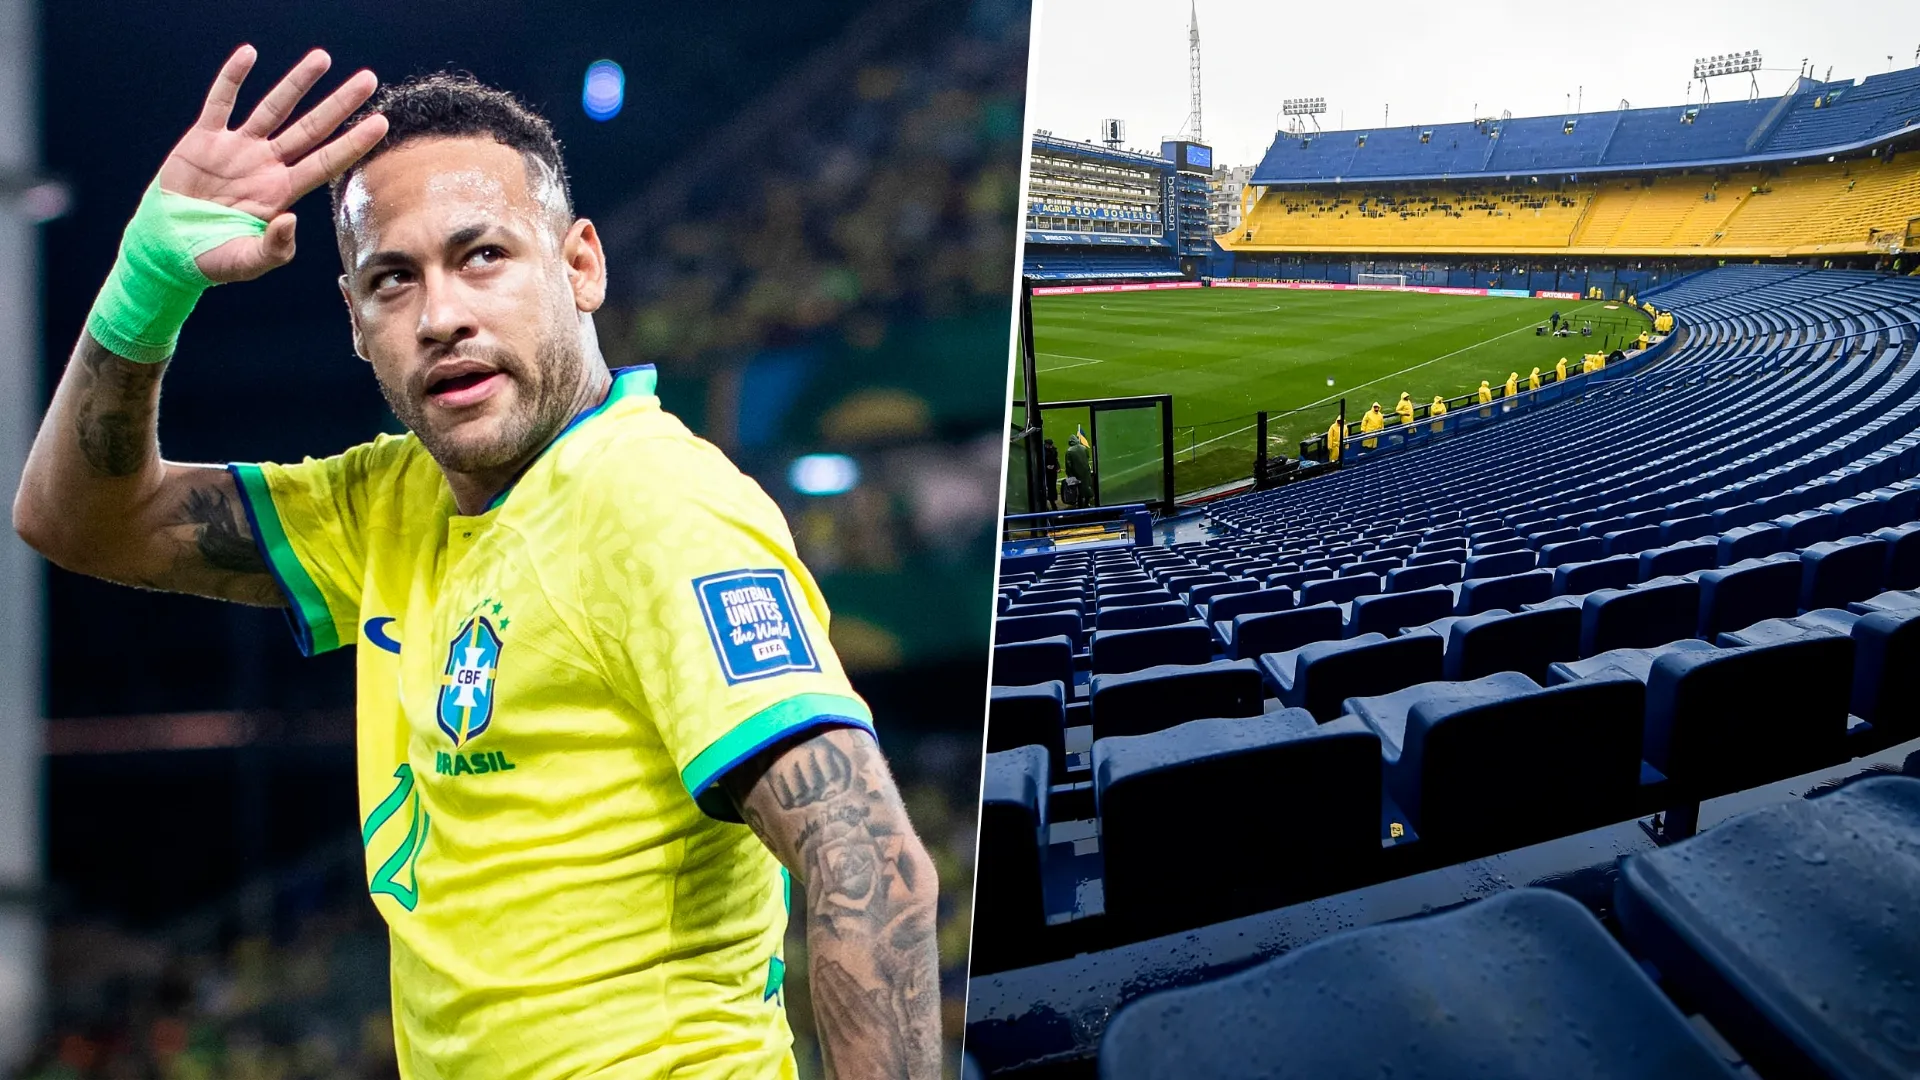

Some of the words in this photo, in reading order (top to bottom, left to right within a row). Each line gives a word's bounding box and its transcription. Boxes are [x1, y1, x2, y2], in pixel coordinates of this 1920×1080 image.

[1076, 206, 1098, 216] SOY
[1104, 209, 1152, 220] BOSTERO
[1542, 291, 1574, 300] GATORADE
[720, 586, 776, 608] FOOTBALL
[726, 601, 783, 627] UNITES
[729, 625, 755, 646] the
[753, 620, 791, 640] World
[758, 643, 783, 656] FIFA
[458, 669, 481, 685] CBF
[436, 750, 516, 776] BRASIL
